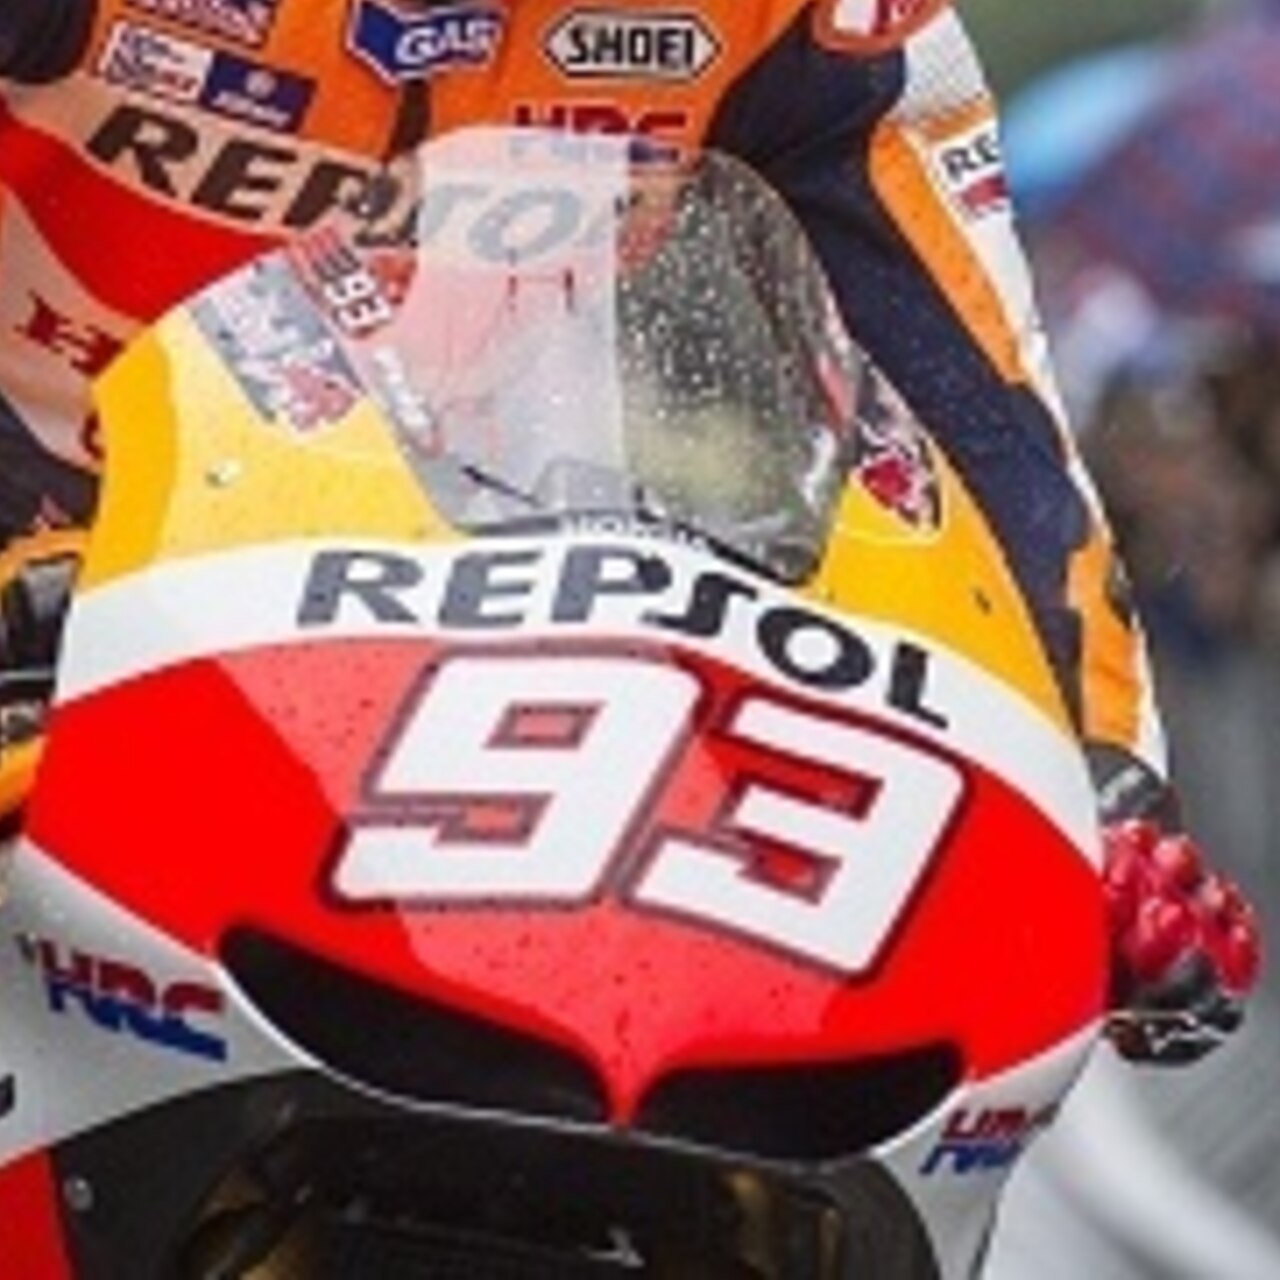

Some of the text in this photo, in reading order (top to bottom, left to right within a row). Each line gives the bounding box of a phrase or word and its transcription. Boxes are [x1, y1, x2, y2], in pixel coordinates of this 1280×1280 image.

[565, 27, 696, 67] SHOEI
[296, 548, 950, 730] REPSOL
[328, 652, 967, 976] 93
